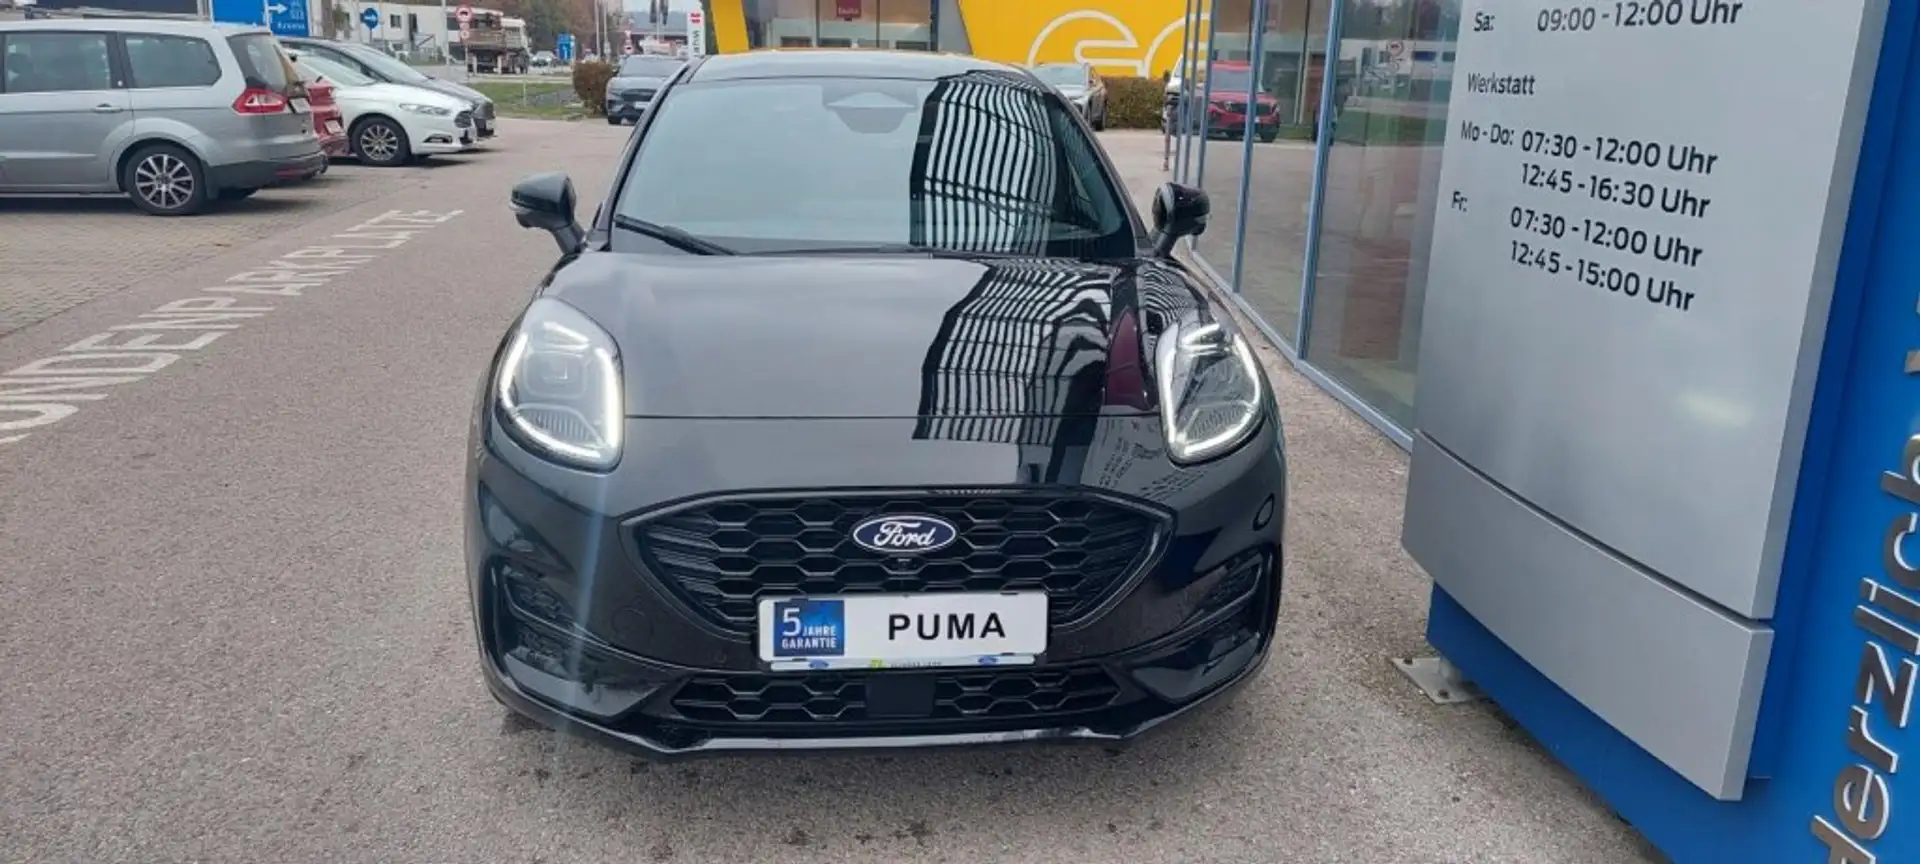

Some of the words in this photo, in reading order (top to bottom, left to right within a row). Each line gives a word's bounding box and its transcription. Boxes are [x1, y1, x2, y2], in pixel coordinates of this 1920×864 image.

[1473, 12, 1495, 33] Sa:
[1537, 7, 1596, 33] 09:00
[1614, 0, 1684, 27] 12:00
[1689, 0, 1744, 25] Uhr
[1467, 72, 1536, 96] Werkstatt
[1460, 120, 1481, 142] Mo
[1489, 124, 1515, 146] Do:
[1521, 130, 1577, 159] 07:30
[1595, 137, 1662, 169] 12:00
[1666, 144, 1719, 176] Uhr
[1522, 163, 1573, 194] 12:45
[1589, 175, 1655, 209] 16:30
[1660, 187, 1712, 219] Uhr
[1510, 206, 1566, 240] 07:30
[1583, 219, 1648, 255] 12:00
[1653, 235, 1704, 268] Uhr
[1511, 240, 1561, 275] 12:45
[1577, 259, 1641, 298] 15:00
[1645, 277, 1696, 312] Uhr
[873, 520, 936, 548] Ford
[782, 606, 802, 637] 5
[802, 624, 837, 637] JAHRE
[887, 612, 1007, 641] PUMA
[781, 637, 838, 650] GARANTIE
